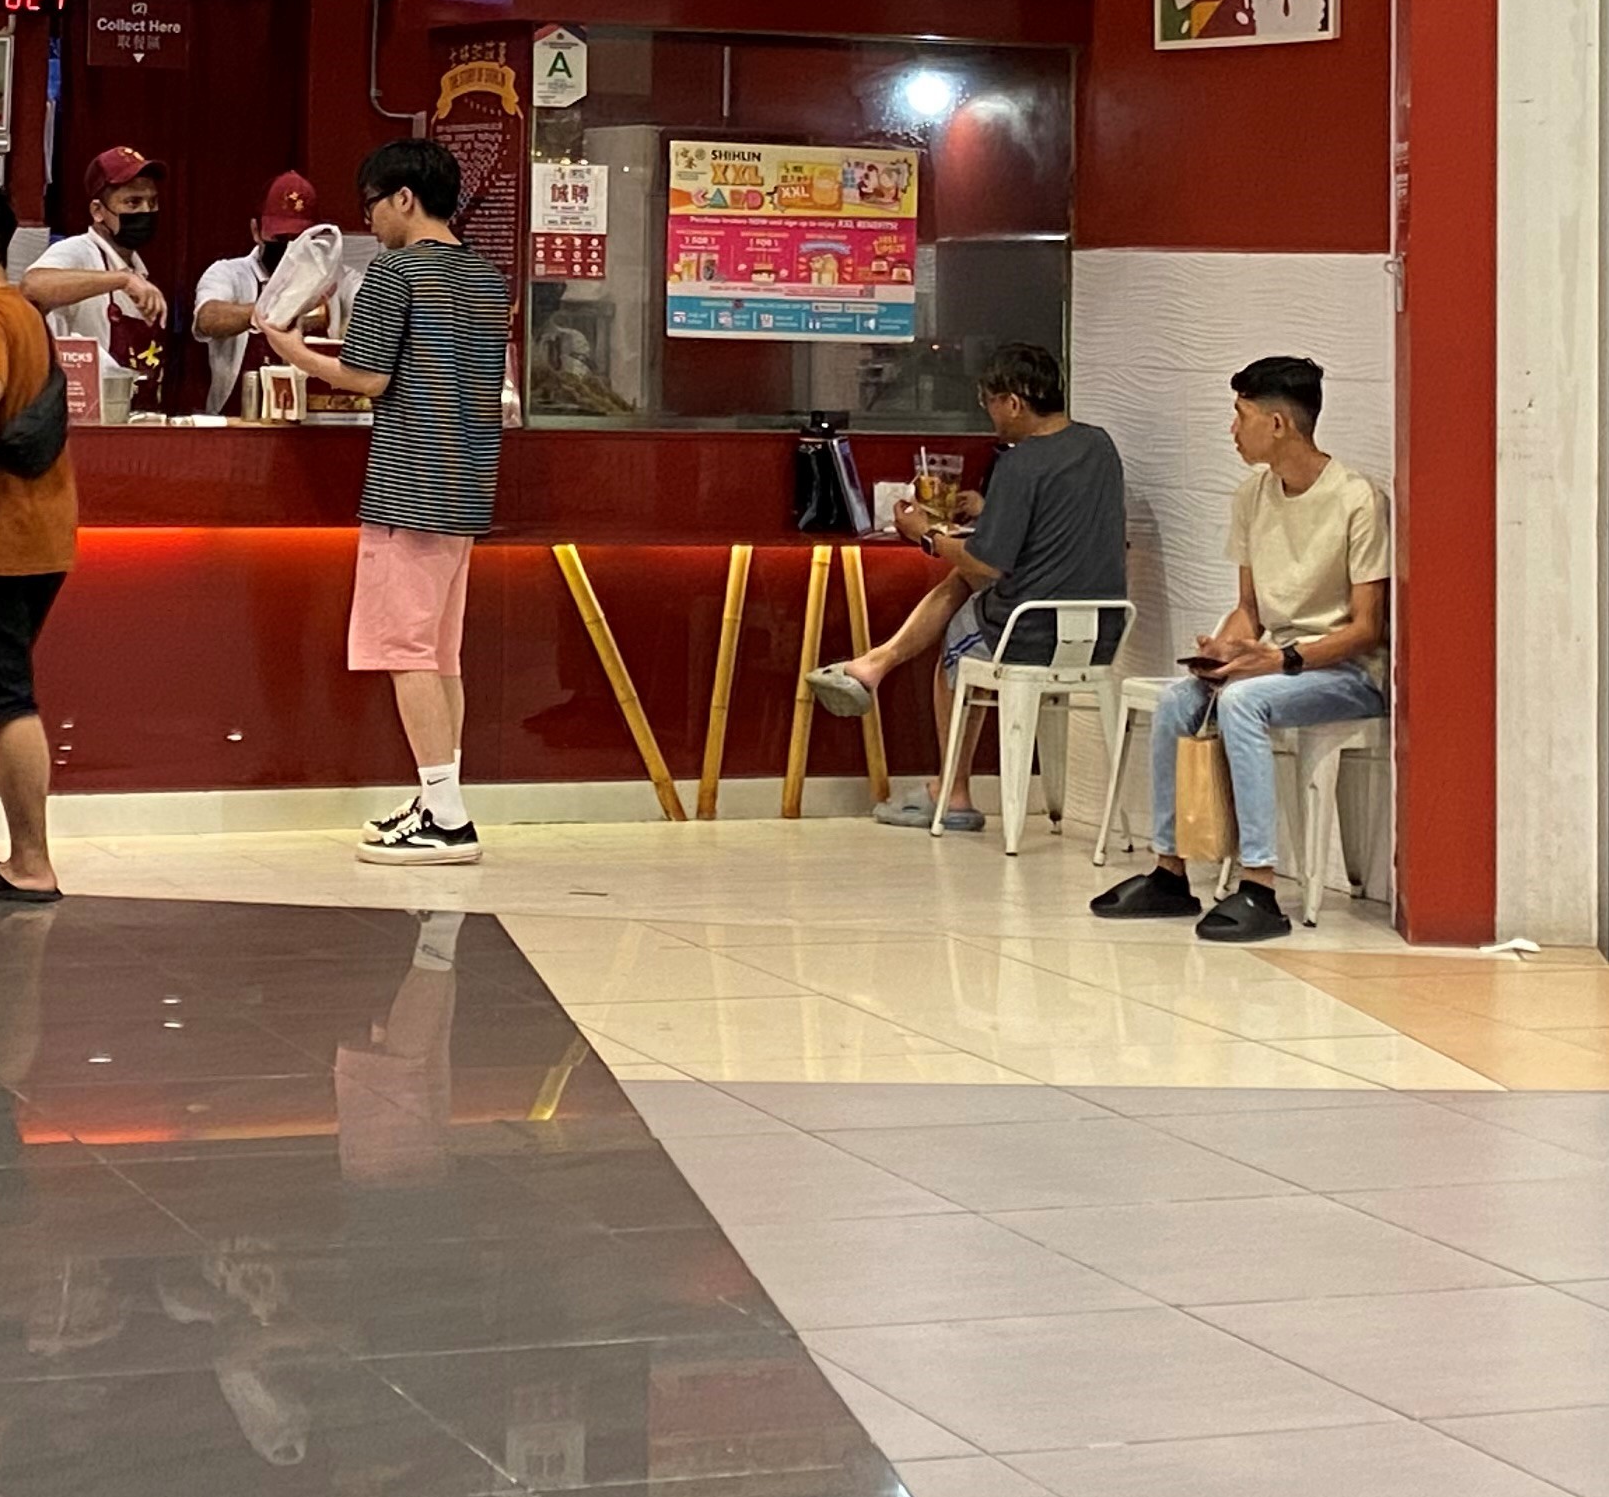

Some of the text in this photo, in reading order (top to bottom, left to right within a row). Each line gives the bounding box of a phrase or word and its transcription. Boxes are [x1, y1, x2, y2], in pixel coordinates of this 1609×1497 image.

[96, 17, 182, 34] Collect Here
[546, 51, 572, 79] A
[711, 149, 762, 162] SHIHLIN
[711, 163, 765, 187] XXL
[781, 185, 810, 199] XXL
